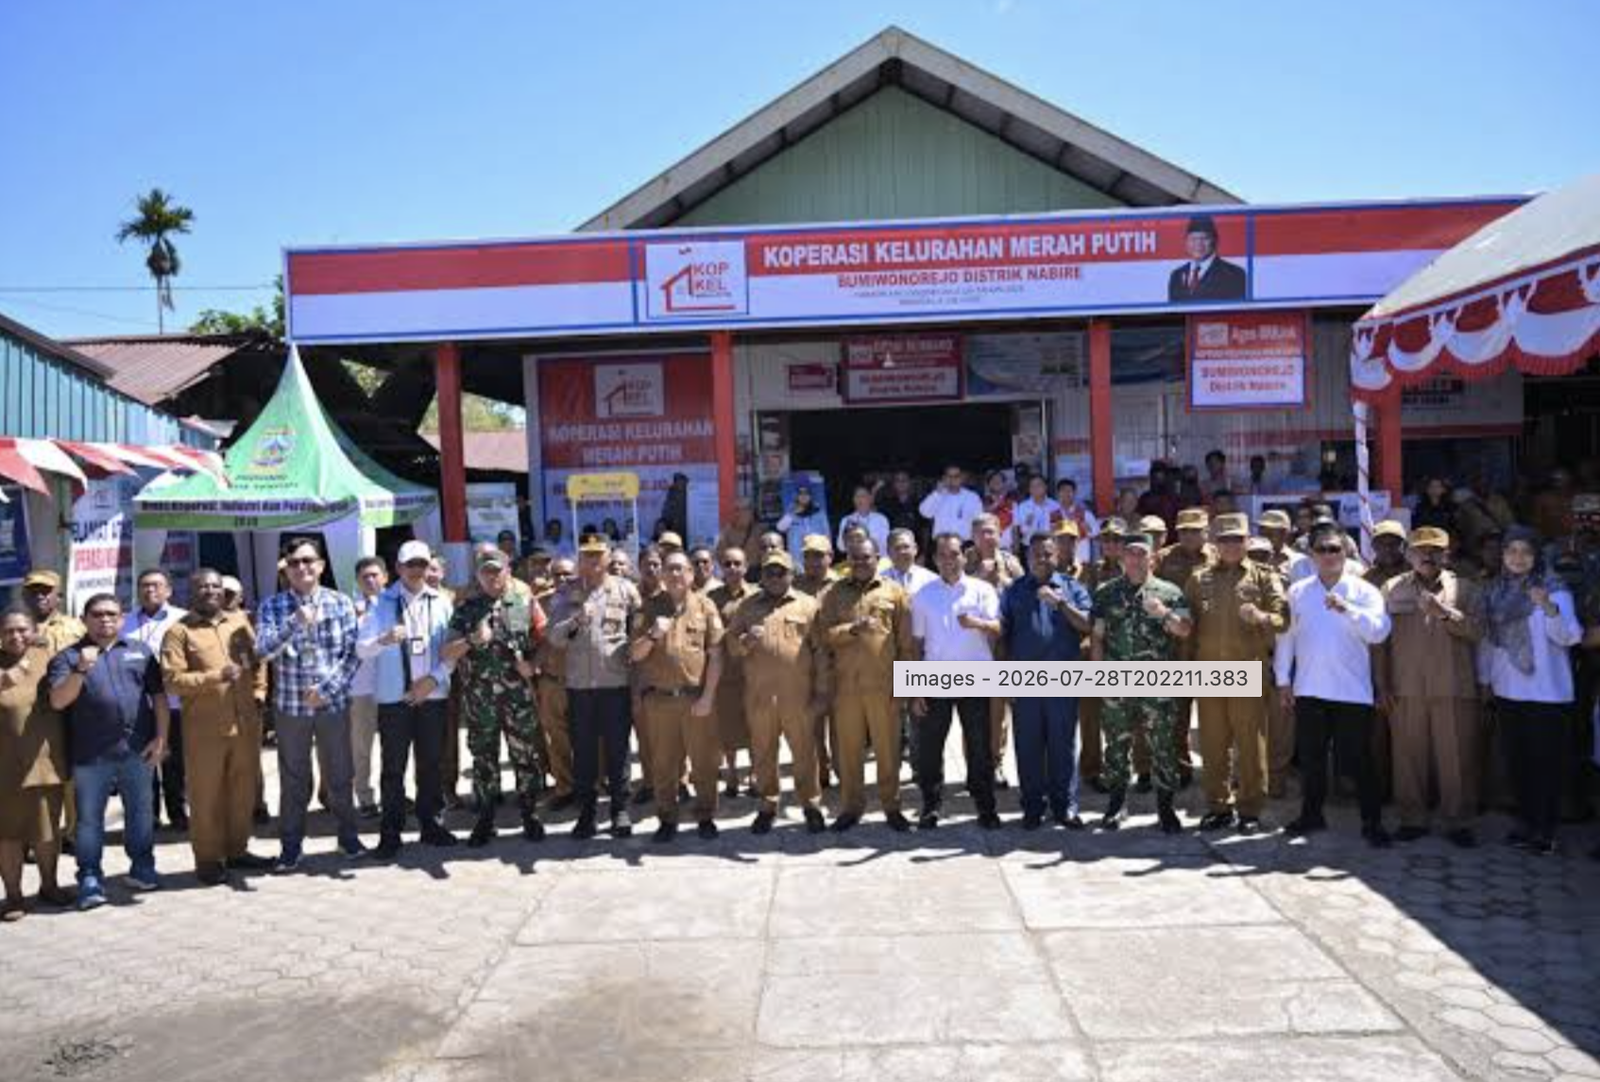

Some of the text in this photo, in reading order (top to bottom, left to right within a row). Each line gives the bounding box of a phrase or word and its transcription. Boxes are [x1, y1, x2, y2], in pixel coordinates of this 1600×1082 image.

[764, 231, 1157, 267] KOPERASI KELURAHAN MERAH PUTIH
[693, 261, 729, 275] KOP
[838, 265, 1081, 288] BUMIWONOREJO DISTRIK NABIRE
[693, 279, 728, 291] KEL
[625, 419, 714, 440] KELURAHAN
[637, 443, 682, 462] PUTIH
